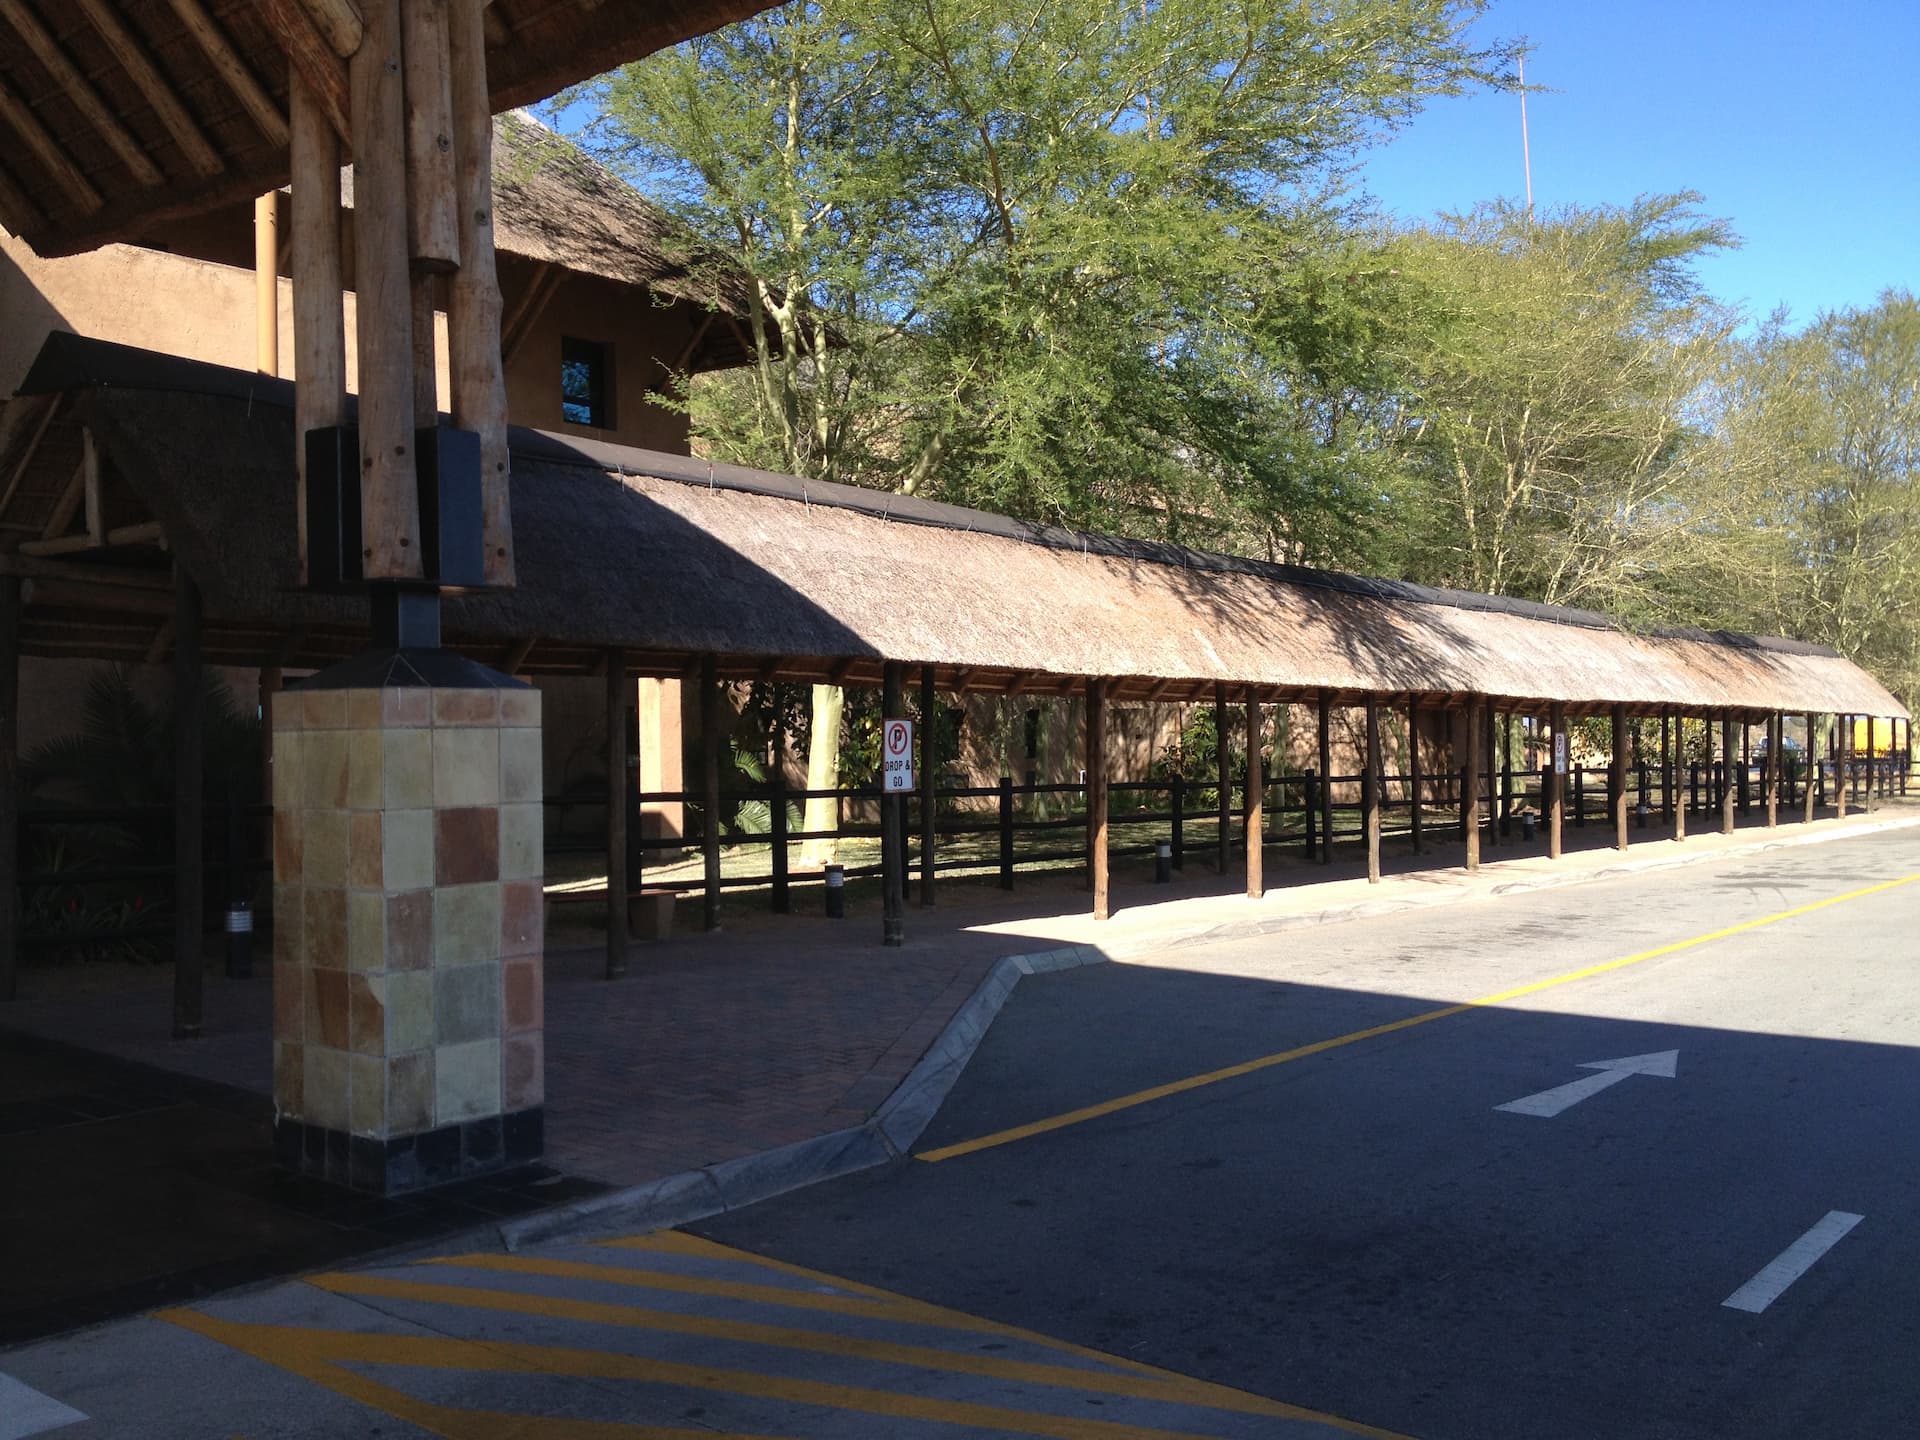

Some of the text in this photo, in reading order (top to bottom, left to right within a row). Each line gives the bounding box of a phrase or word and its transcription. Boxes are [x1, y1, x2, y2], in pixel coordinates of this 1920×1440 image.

[894, 729, 902, 749] P
[885, 760, 910, 771] DROP &
[893, 776, 903, 787] GO
